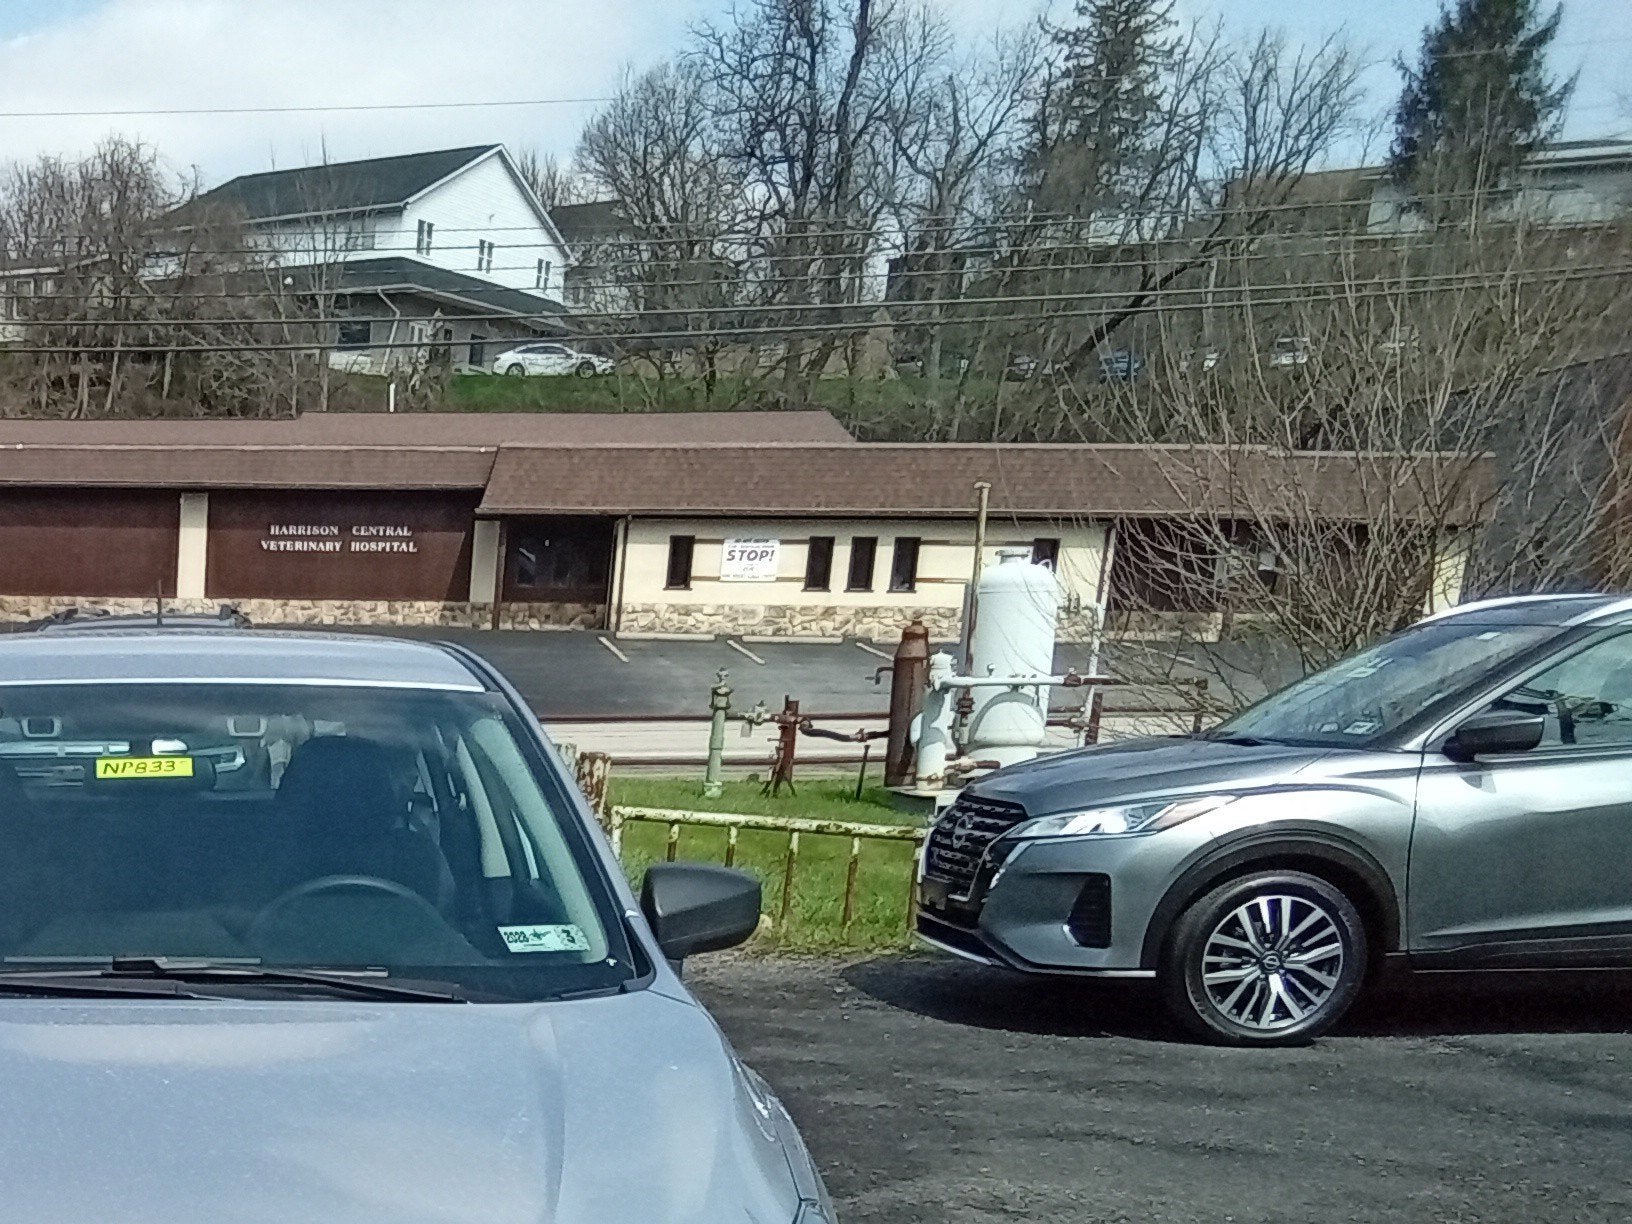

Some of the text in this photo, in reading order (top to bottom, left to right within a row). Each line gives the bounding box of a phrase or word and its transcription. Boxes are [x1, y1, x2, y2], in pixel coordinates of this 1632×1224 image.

[269, 525, 413, 537] HARRISON CENTRAL
[260, 540, 418, 553] VETERINARY HOSPITAL
[726, 549, 776, 562] STOP!
[102, 759, 176, 775] NP833
